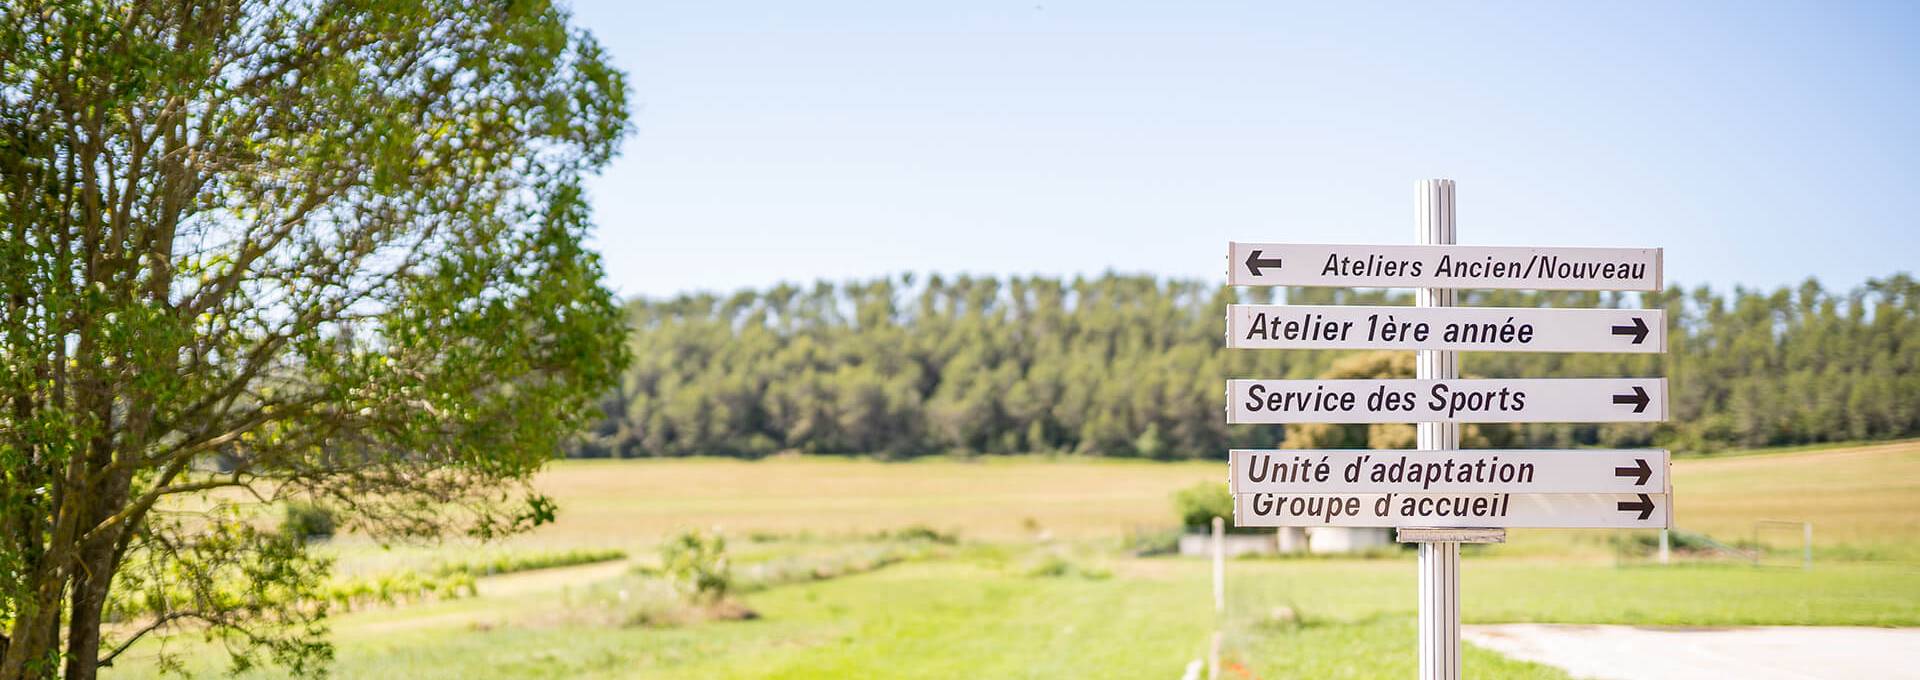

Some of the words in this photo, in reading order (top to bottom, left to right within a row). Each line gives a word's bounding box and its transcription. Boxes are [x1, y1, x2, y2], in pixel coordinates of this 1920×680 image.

[1321, 254, 1422, 278] Ateliers
[1435, 254, 1646, 280] Ancien/Nouveau
[1246, 313, 1353, 341] Atelier
[1367, 314, 1429, 342] 1ère
[1443, 317, 1534, 343] année
[1245, 384, 1355, 412] Service
[1367, 385, 1416, 412] des
[1428, 383, 1526, 418] Sports
[1248, 455, 1330, 483] Unité
[1344, 455, 1535, 490] d'adaptation
[1253, 493, 1361, 523] Groupe
